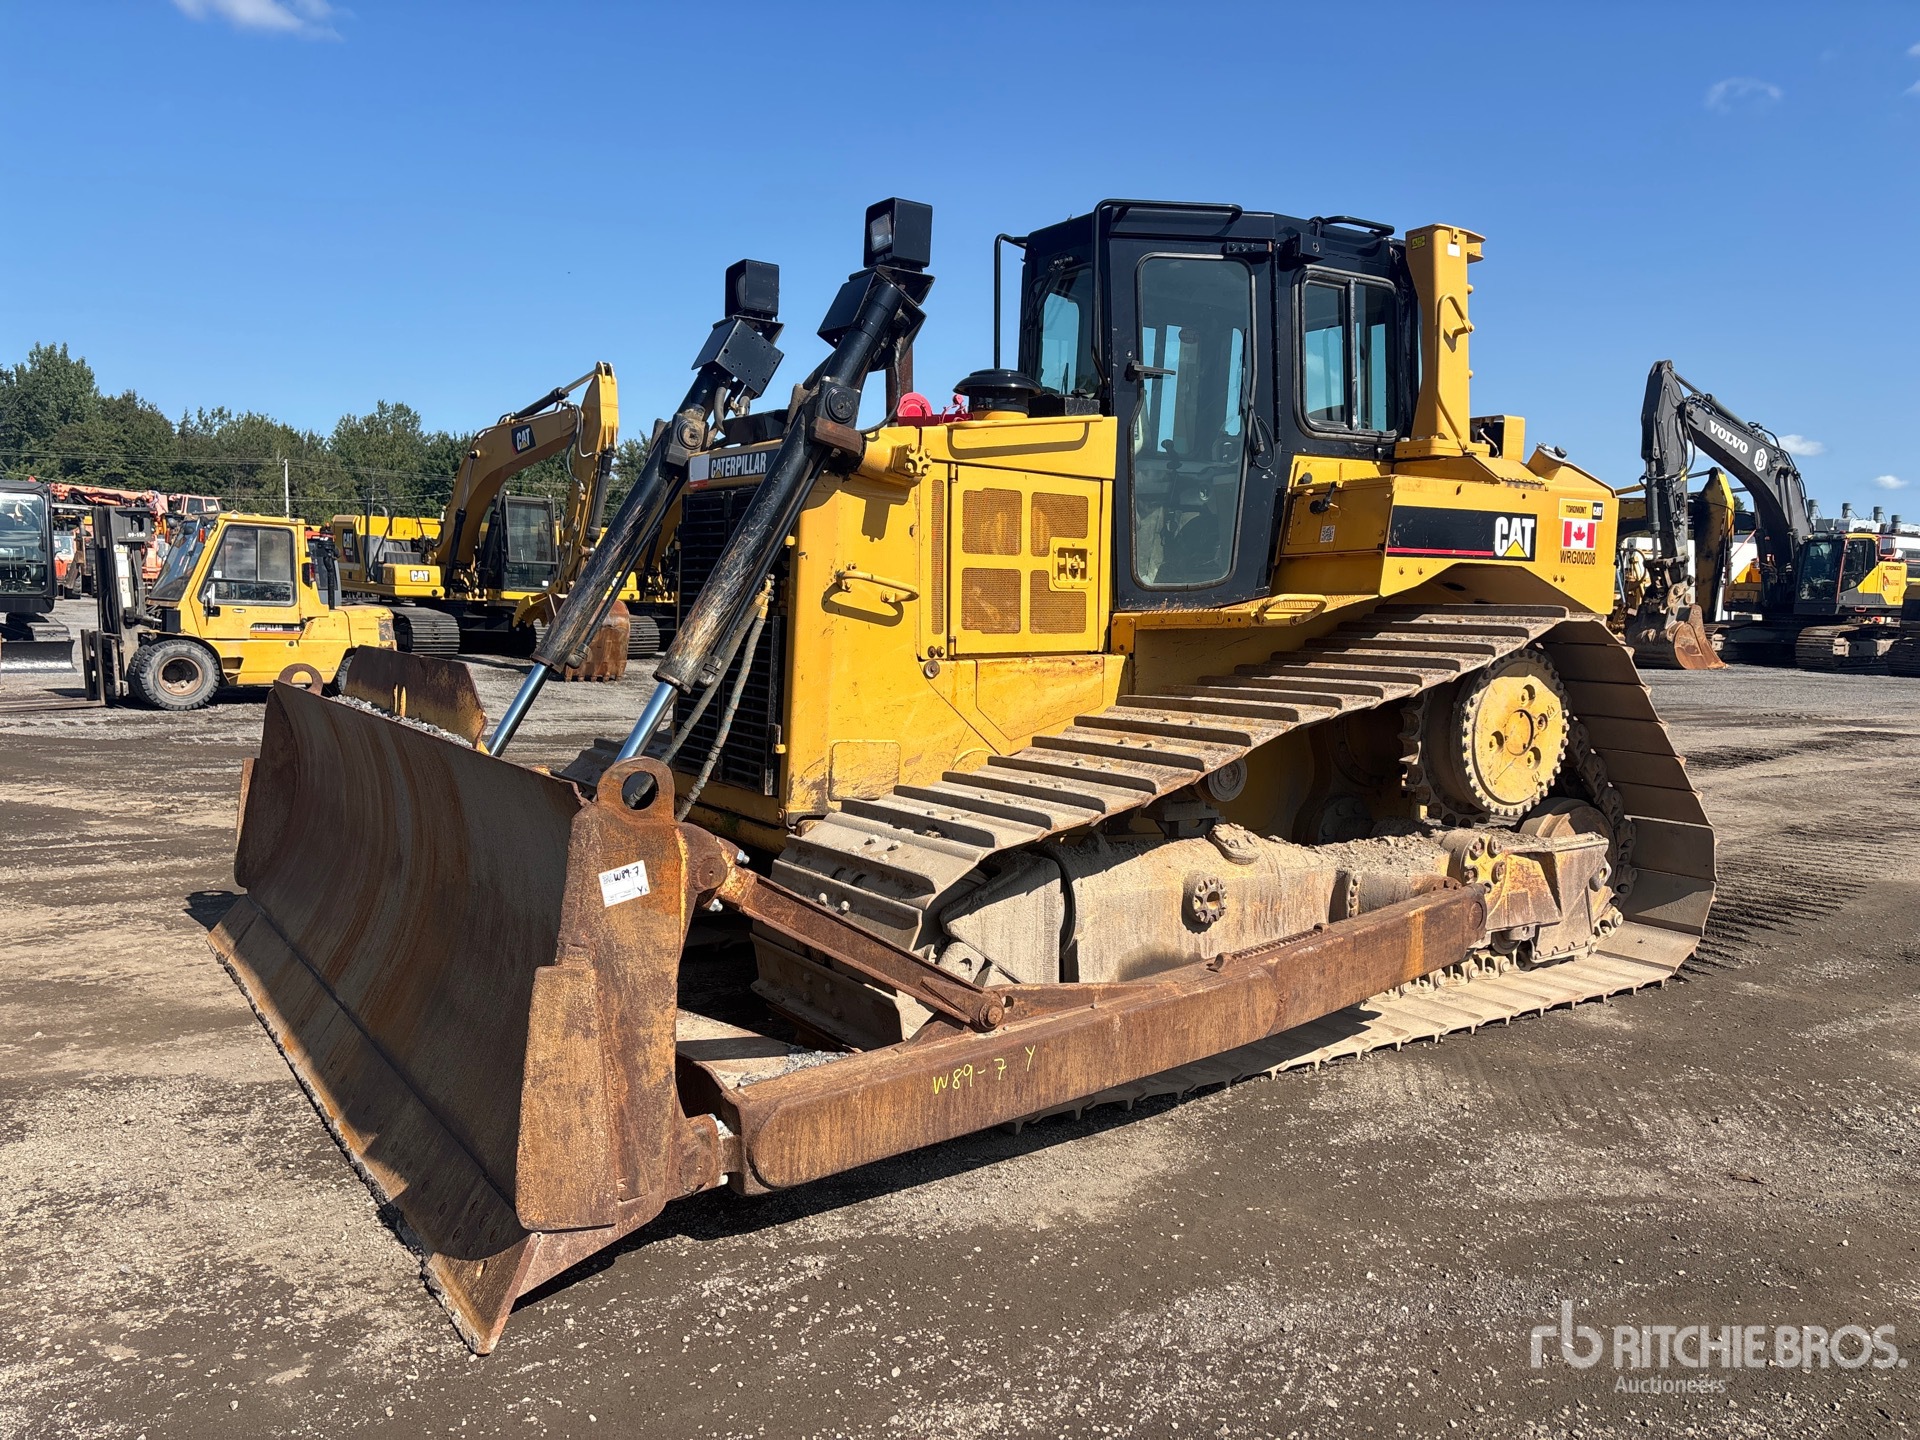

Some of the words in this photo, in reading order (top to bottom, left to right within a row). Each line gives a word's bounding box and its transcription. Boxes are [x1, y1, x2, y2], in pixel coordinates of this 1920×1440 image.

[516, 427, 530, 451] CAT
[1709, 420, 1748, 454] VOLVO
[710, 452, 767, 478] CATERPILLAR
[1592, 506, 1603, 516] CAT
[1494, 516, 1535, 558] CAT
[1559, 550, 1596, 565] WRG00208
[411, 570, 429, 582] CAT
[251, 624, 283, 632] TERPILLAR
[613, 865, 639, 881] W89-7
[1025, 1045, 1036, 1072] Y
